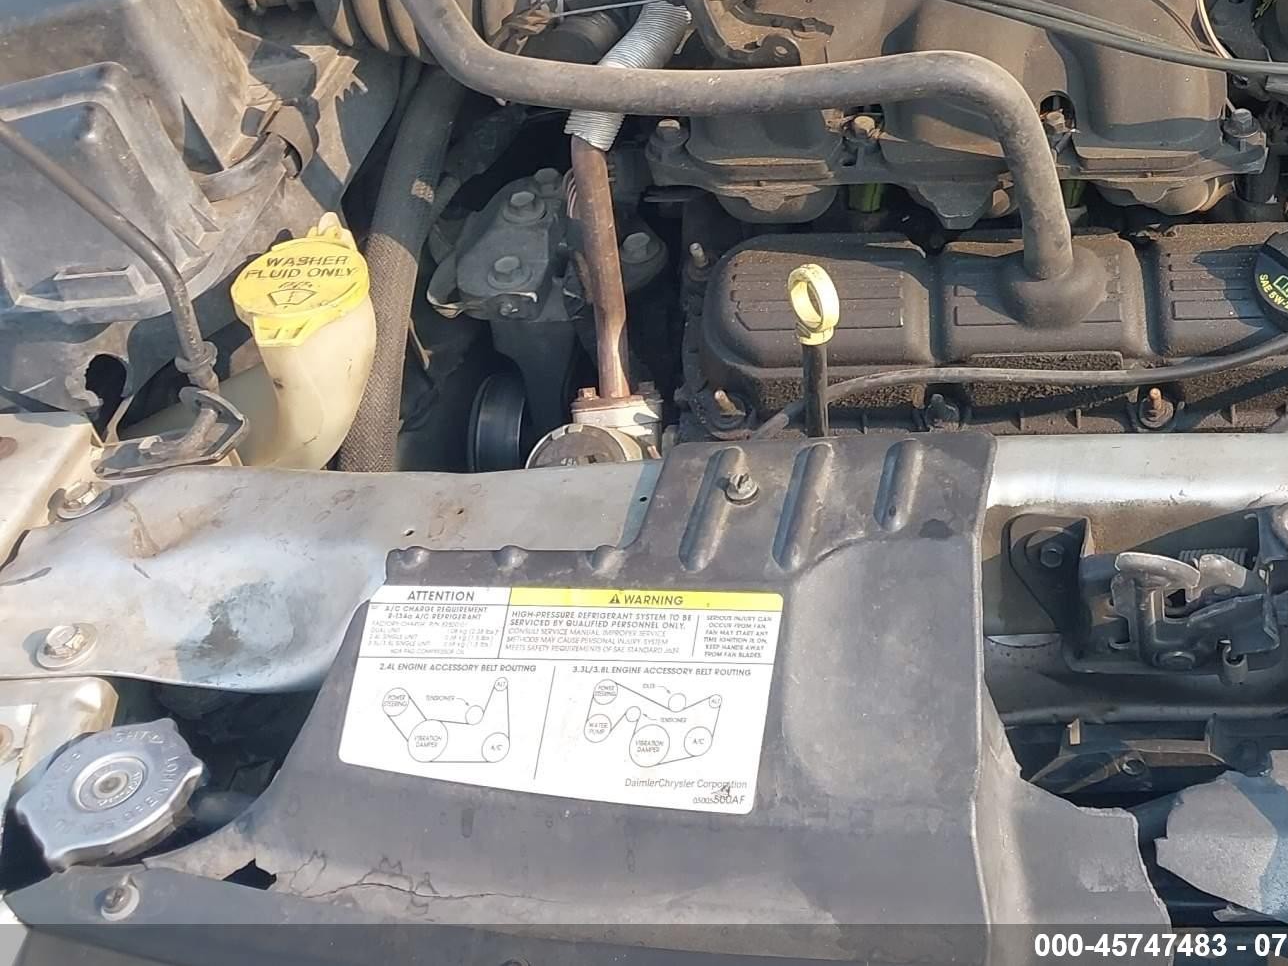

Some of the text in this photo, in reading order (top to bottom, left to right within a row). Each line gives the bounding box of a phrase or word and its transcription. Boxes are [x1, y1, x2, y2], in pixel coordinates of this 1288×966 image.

[267, 255, 348, 267] WASHER
[244, 266, 358, 280] FLUID ONLY
[1259, 273, 1273, 293] SAE
[407, 590, 475, 602] ATTENTION
[623, 594, 684, 605] WARNING
[403, 605, 434, 613] CHARGE
[511, 611, 575, 619] HIGH-PRESSURE
[577, 612, 633, 620] REFRIGERANT
[635, 612, 666, 621] SYSTEM
[683, 614, 692, 622] BE
[510, 618, 686, 630] SERVICED BY QUALIFIED PERSONNEL ONLY.
[580, 637, 616, 645] PERSONAL
[551, 645, 601, 653] REQUIREMENTS
[627, 646, 662, 654] STANDARD
[379, 663, 537, 673] 2.4L ENGINE ACCESSORY BELT ROUTING
[572, 665, 752, 677] 3.3L/3.8L ENGINE ACCESSORY BELT ROUTING
[624, 778, 748, 791] DaimlerChrysler Corporation
